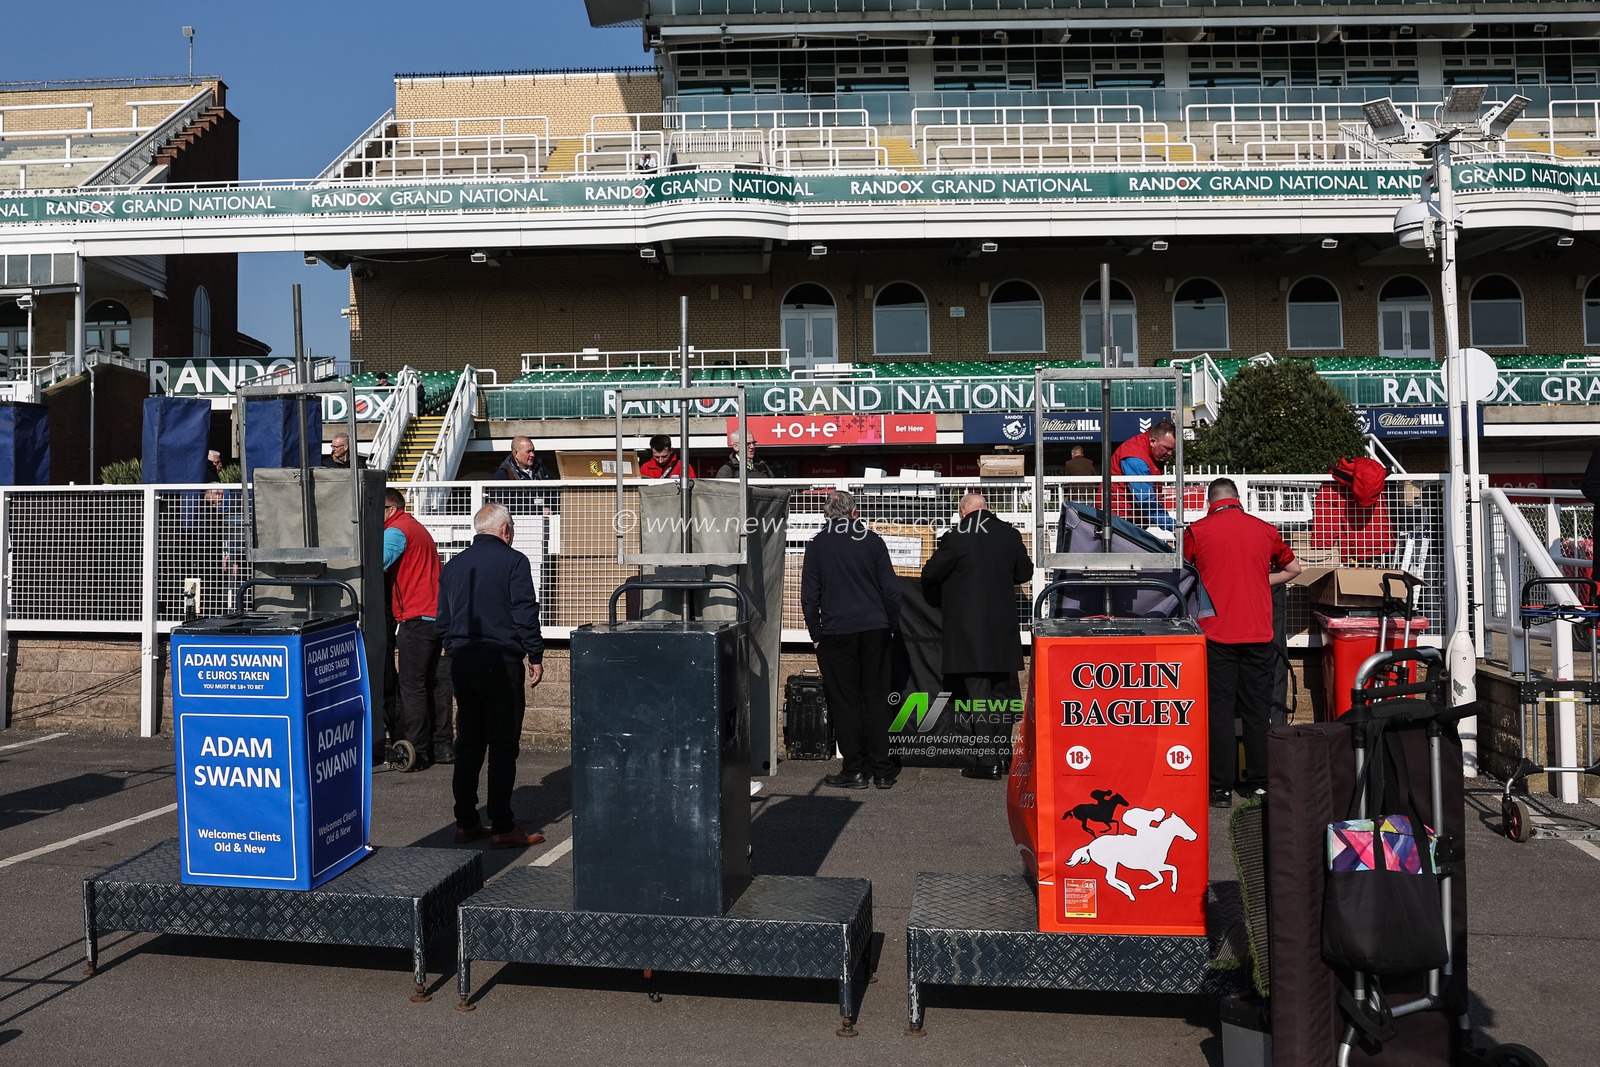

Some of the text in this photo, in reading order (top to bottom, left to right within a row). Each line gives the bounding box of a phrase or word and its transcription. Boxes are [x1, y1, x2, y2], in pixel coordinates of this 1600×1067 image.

[850, 178, 1092, 195] RANDOX GRAND NATIONAL
[1129, 175, 1368, 192] RANDOX GRAND NATIONAL
[1377, 174, 1427, 190] RAND
[1459, 167, 1600, 186] GRAND NATIONAL
[311, 187, 548, 208] RANDOX GRAND NATIONAL
[585, 178, 813, 200] RANDOX GRAND NATIONAL
[46, 195, 276, 215] RANDOX GRAND NATIONAL
[764, 386, 881, 412] GRAND
[898, 383, 1065, 410] NATIONAL
[1384, 377, 1522, 403] RANX
[1077, 419, 1101, 431] HILL
[1378, 412, 1444, 426] William HILL
[184, 653, 283, 668] ADAM SWANN
[307, 639, 354, 665] ADAM SWANN
[197, 670, 270, 681] € EUROS TAKEN
[314, 657, 350, 676] € EUROS TAKEN
[1071, 662, 1182, 690] COLIN
[1061, 699, 1195, 727] BAGLEY
[317, 720, 355, 753] ADAM
[200, 736, 272, 758] ADAM
[316, 746, 357, 784] SWANN
[1069, 751, 1090, 765] 18+
[1169, 751, 1190, 765] 18+
[194, 765, 281, 788] SWANN
[318, 808, 357, 837] Welcomes Clients
[198, 829, 281, 842] Welcomes Clients
[326, 833, 335, 846] Old
[340, 825, 352, 838] New
[214, 842, 266, 854] Old & New
